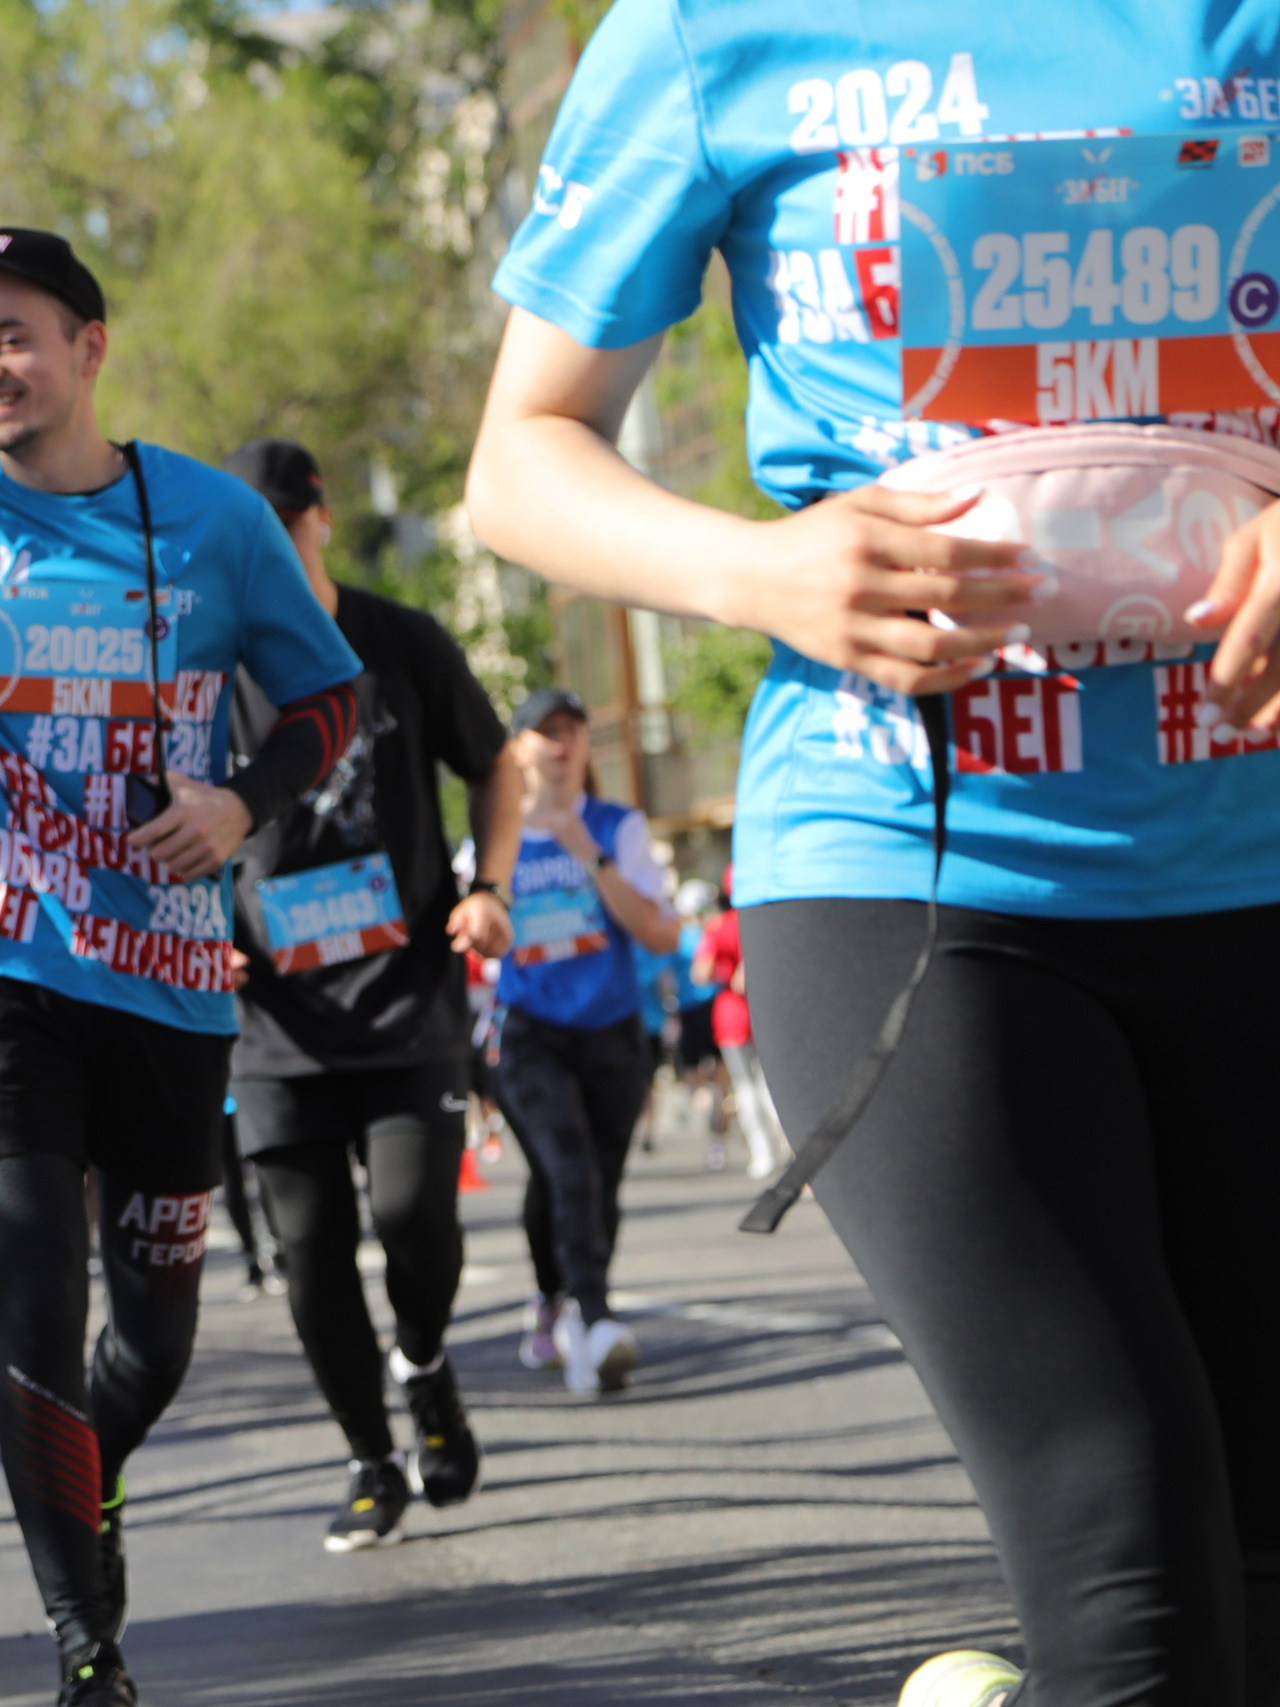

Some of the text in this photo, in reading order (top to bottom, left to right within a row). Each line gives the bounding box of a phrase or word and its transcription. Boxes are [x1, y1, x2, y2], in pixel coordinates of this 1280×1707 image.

[786, 52, 990, 154] 2024
[1175, 77, 1280, 121] ЗАБЕ
[954, 152, 1015, 176] ПСБ
[971, 224, 1221, 330] 25489
[25, 623, 144, 676] 20025
[148, 882, 228, 930] 2024
